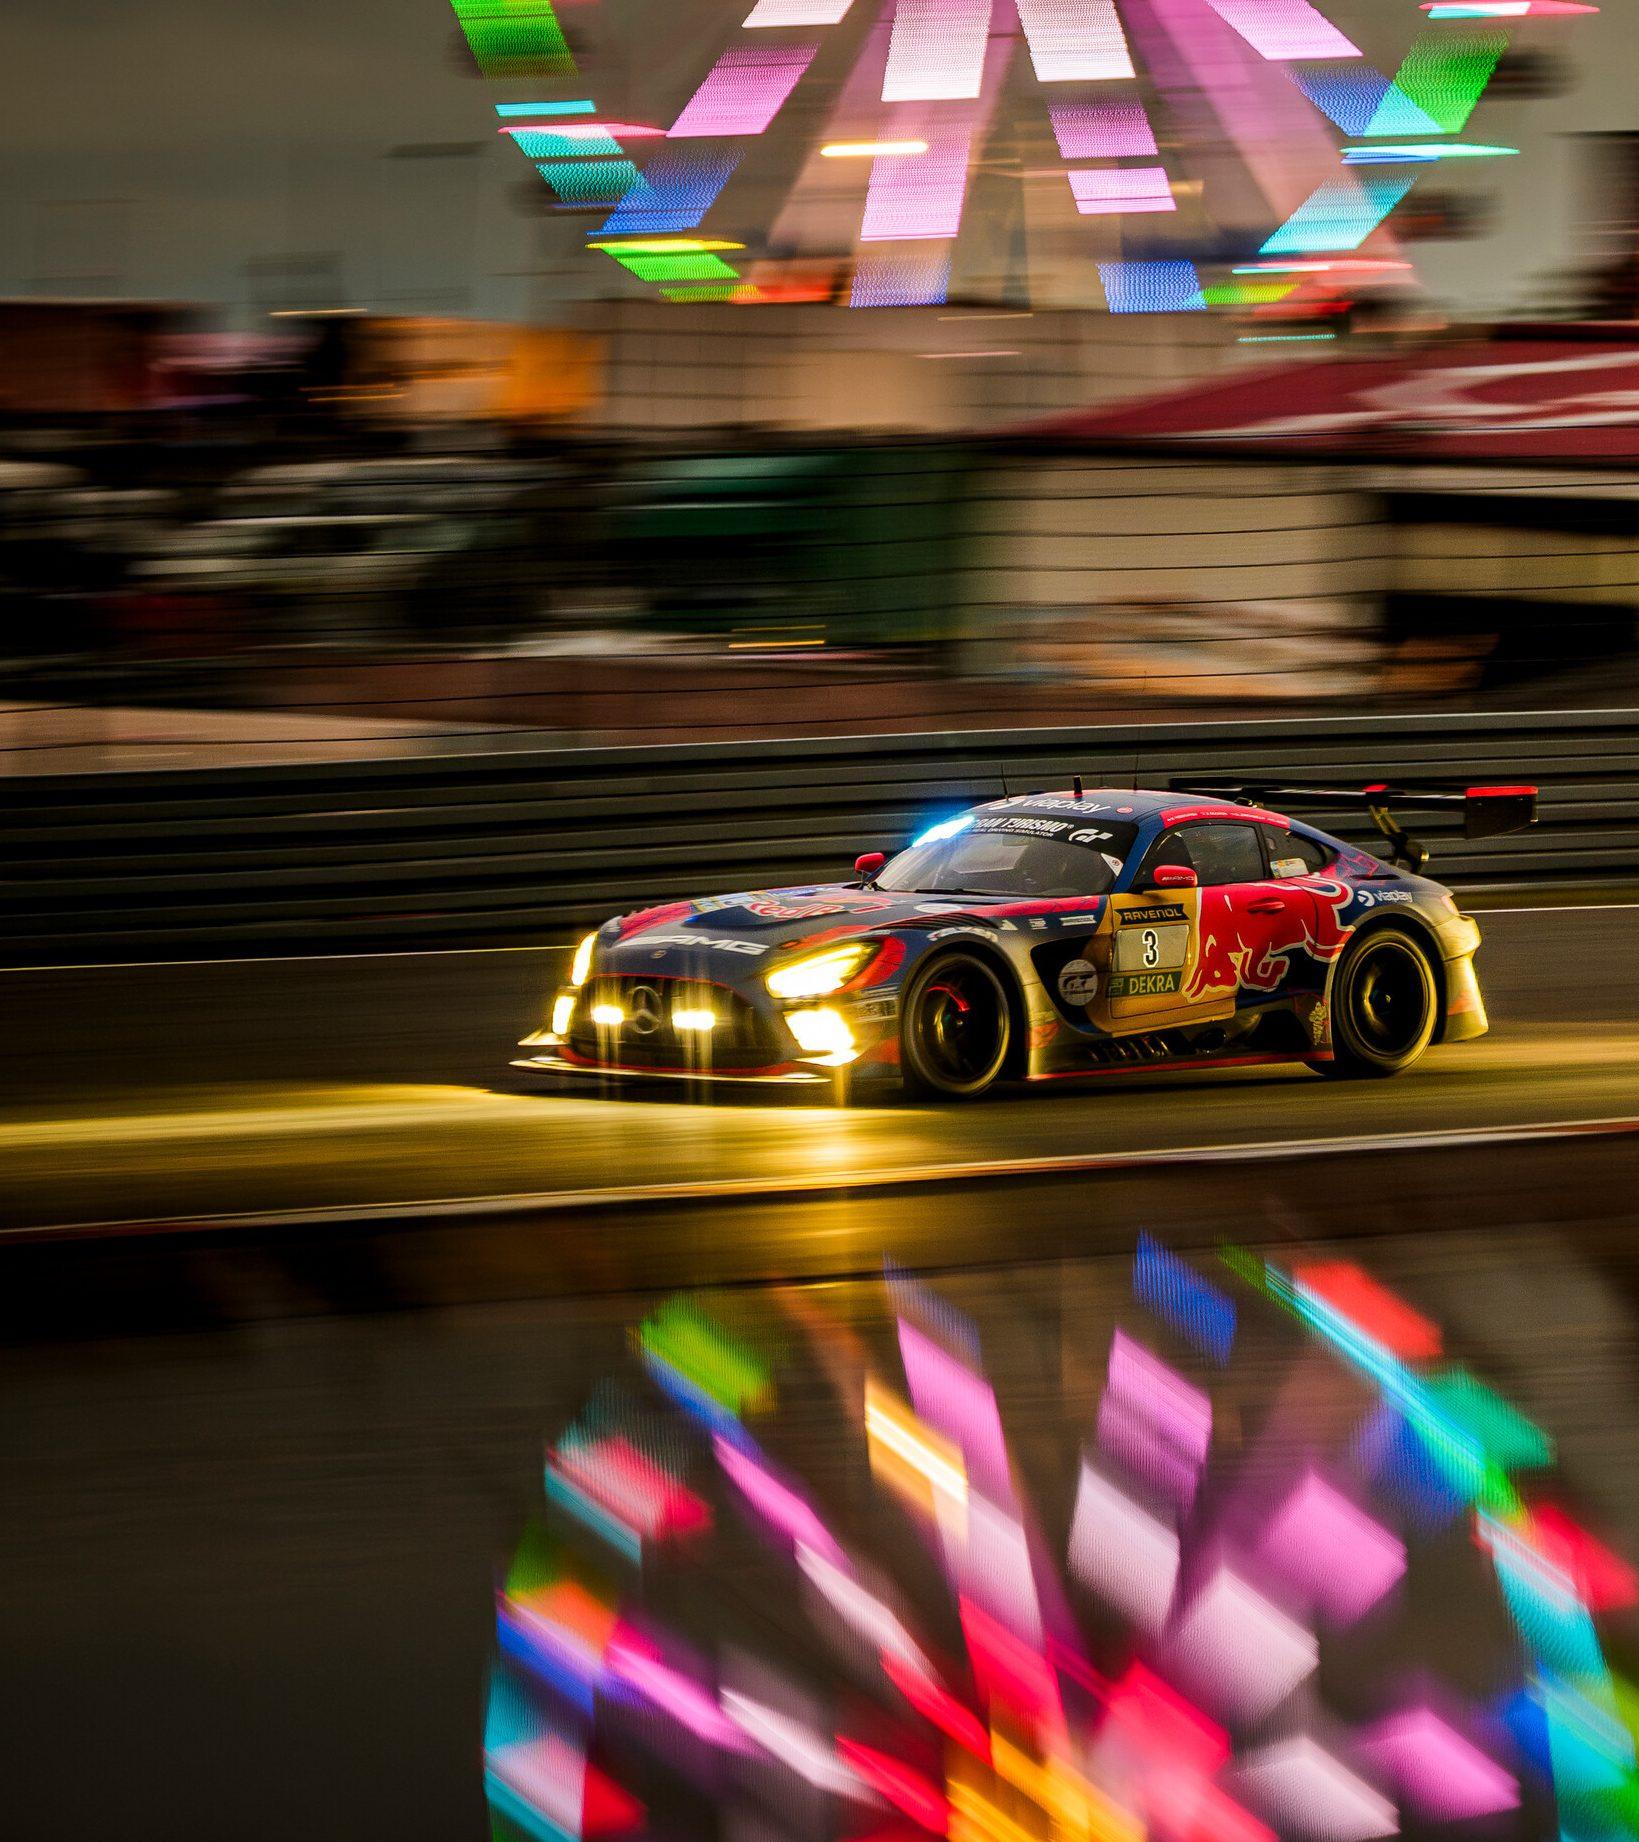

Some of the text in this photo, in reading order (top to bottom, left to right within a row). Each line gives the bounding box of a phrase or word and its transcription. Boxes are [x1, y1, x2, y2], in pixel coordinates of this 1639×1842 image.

[1022, 798, 1111, 814] viaplay
[1124, 908, 1183, 921] RAVENOL
[1142, 929, 1159, 968] 3
[1129, 974, 1175, 995] DEKRA
